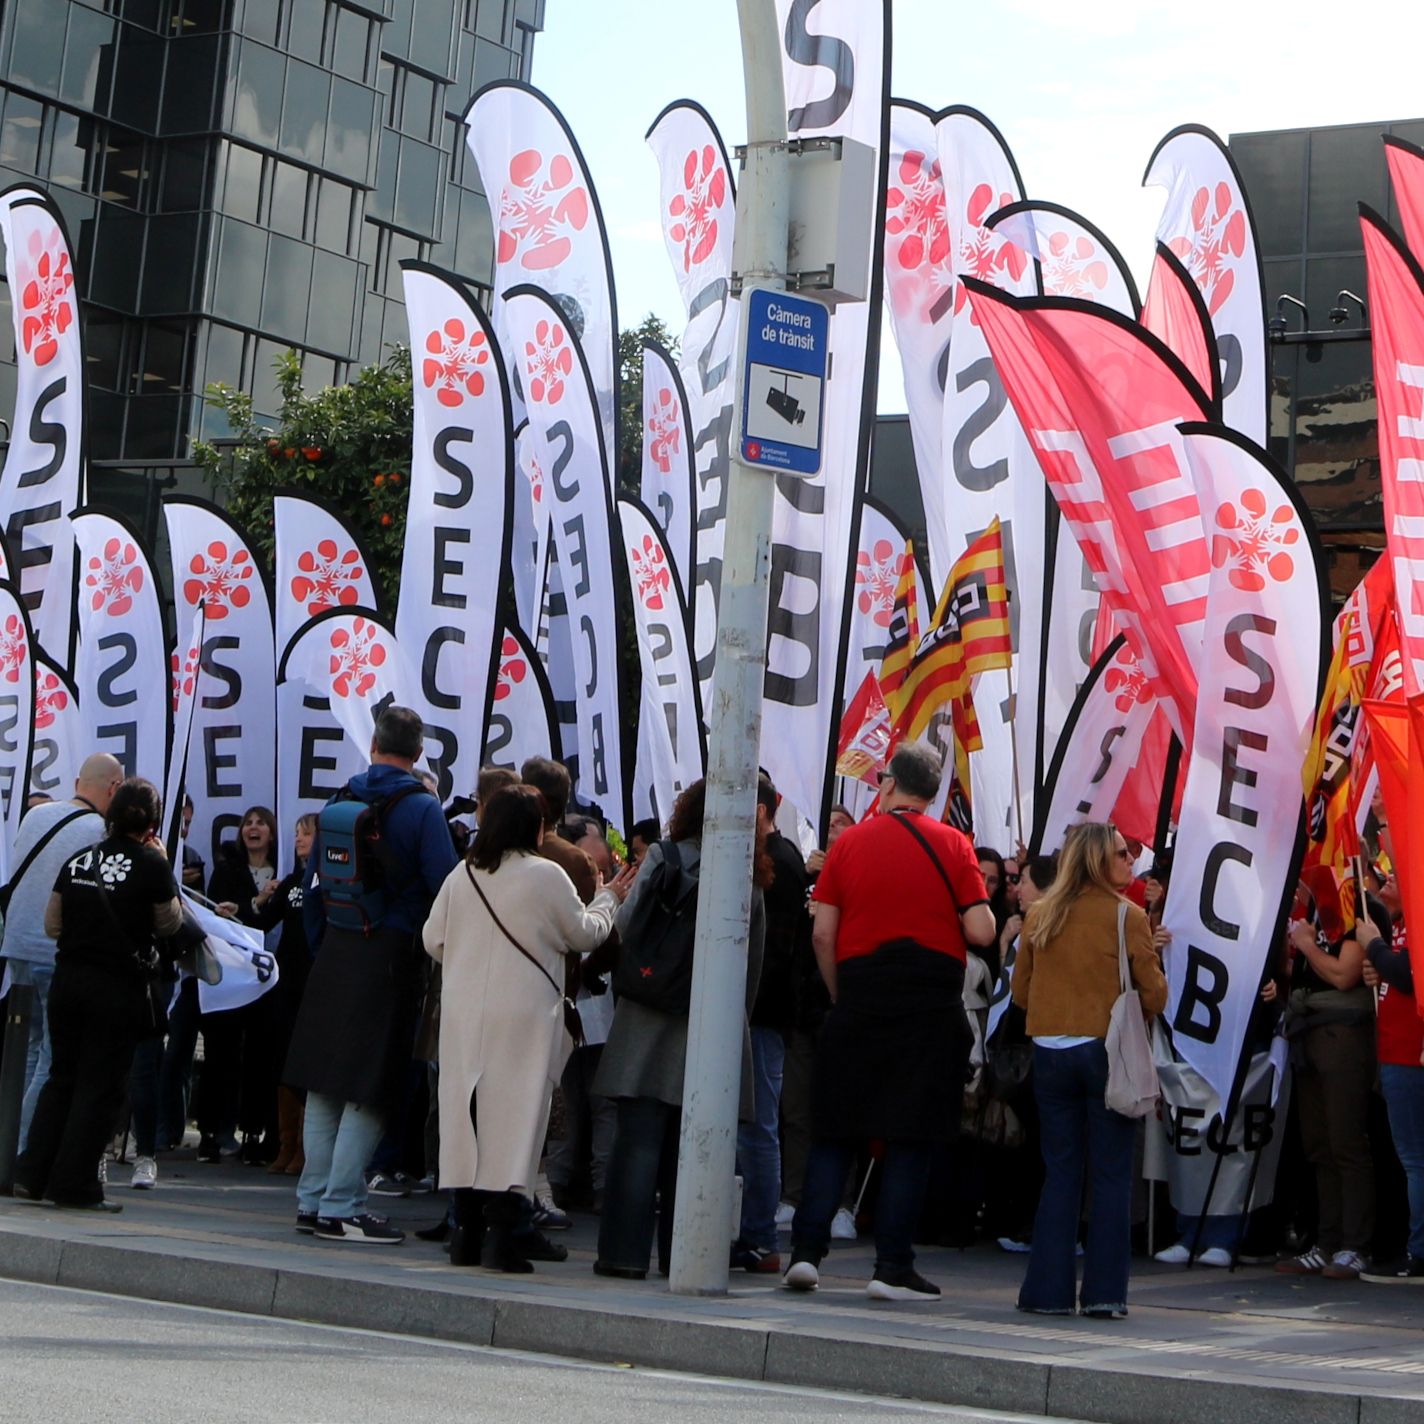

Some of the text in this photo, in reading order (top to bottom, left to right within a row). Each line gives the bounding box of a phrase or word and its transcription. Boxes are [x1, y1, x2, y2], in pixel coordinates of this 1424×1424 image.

[767, 303, 811, 329] Càmera
[762, 324, 815, 351] de trànsit
[1176, 612, 1277, 1044] SECB
[1167, 1103, 1276, 1156] ECB
